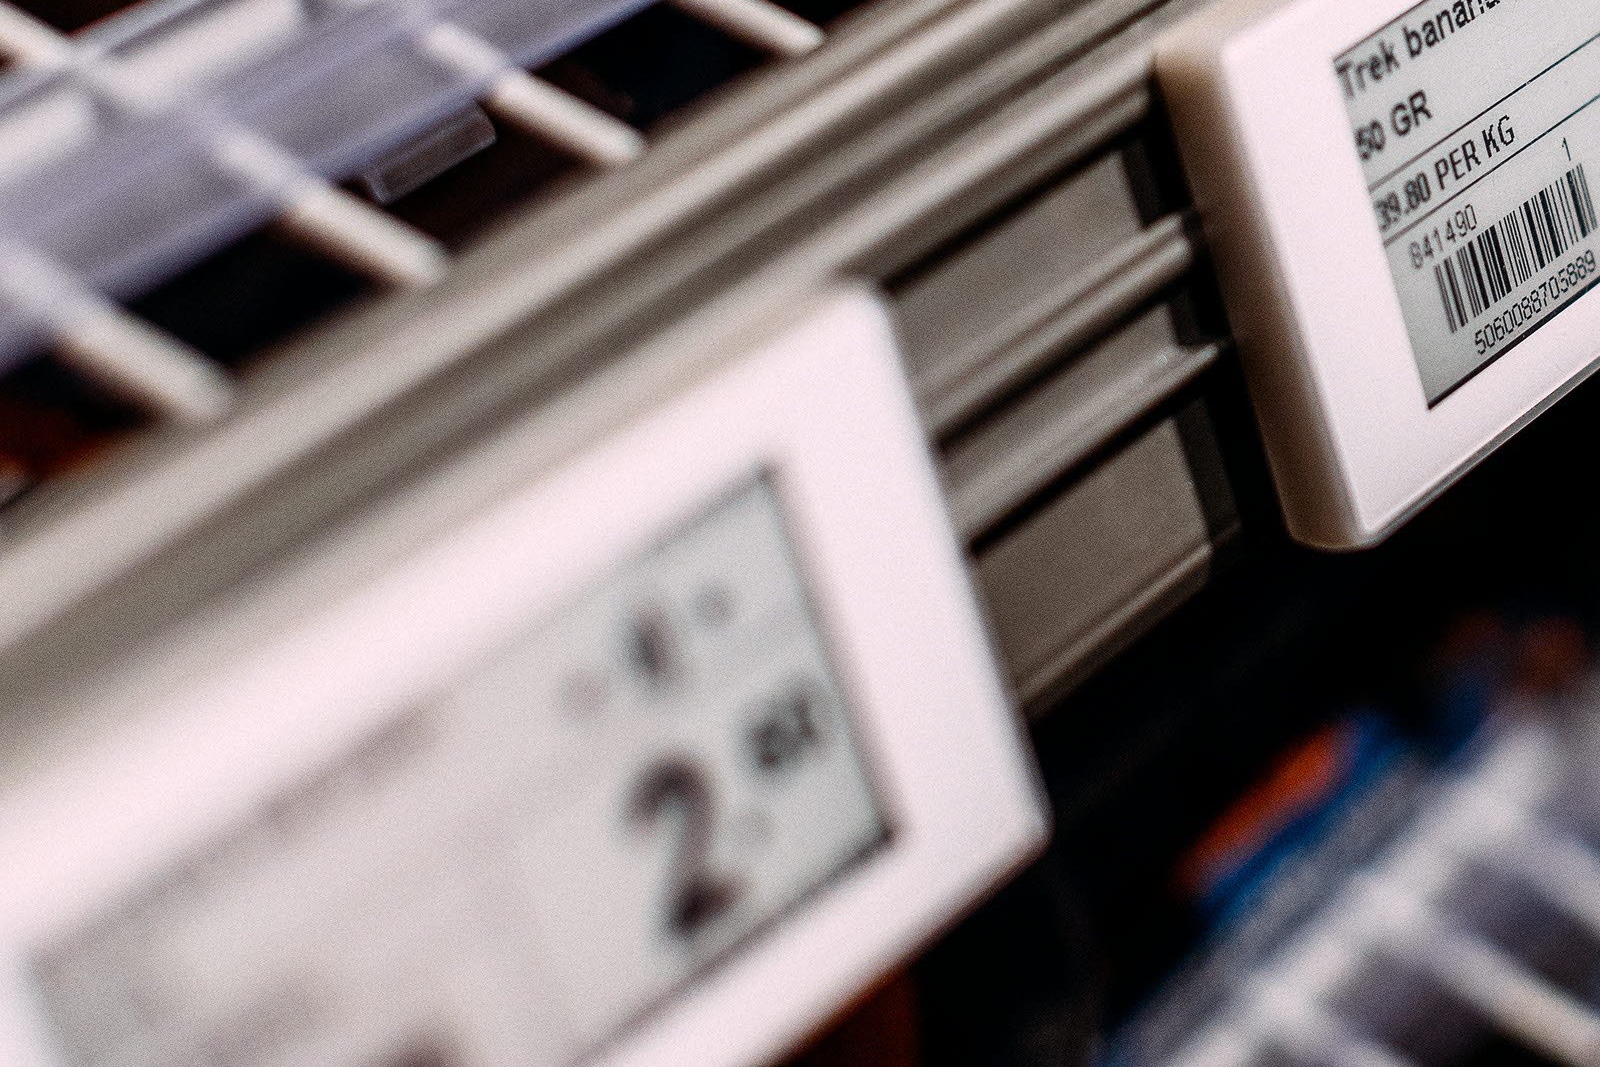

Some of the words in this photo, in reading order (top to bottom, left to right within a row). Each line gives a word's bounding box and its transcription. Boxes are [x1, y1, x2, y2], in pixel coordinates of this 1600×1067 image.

[1335, 40, 1401, 101] Trek
[1353, 119, 1387, 162] 50
[1389, 89, 1433, 137] GR
[1560, 136, 1572, 162] 1
[1374, 171, 1432, 233] 39.80
[1434, 139, 1482, 191] PER
[1481, 114, 1515, 159] KG
[1474, 249, 1597, 355] 5060088705889
